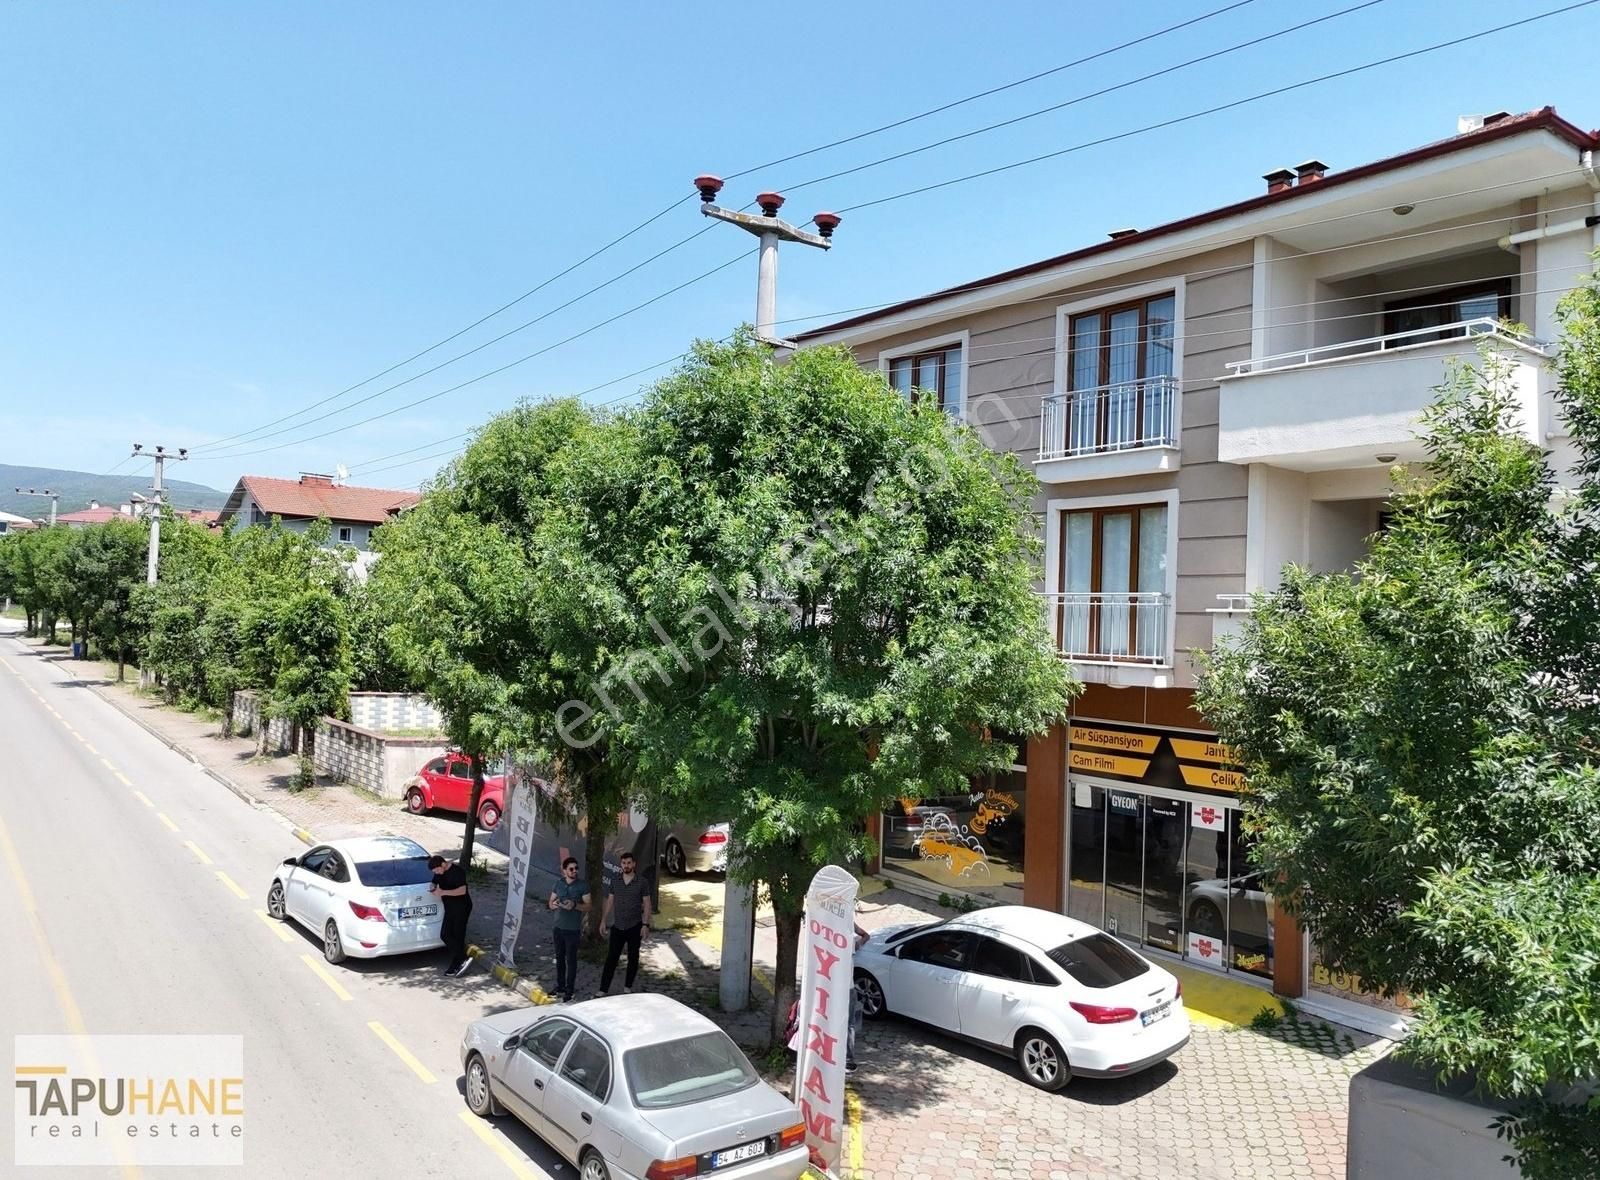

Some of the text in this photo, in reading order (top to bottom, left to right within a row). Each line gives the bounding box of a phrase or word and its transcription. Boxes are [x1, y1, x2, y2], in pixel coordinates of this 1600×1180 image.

[1074, 729, 1144, 749] Air Süspansiyon
[1204, 744, 1226, 758] Jant
[1073, 754, 1115, 770] Cam Filmi
[1211, 772, 1237, 786] Çelik
[1111, 794, 1138, 811] GYEON
[718, 1142, 763, 1165] 54 AZ 603
